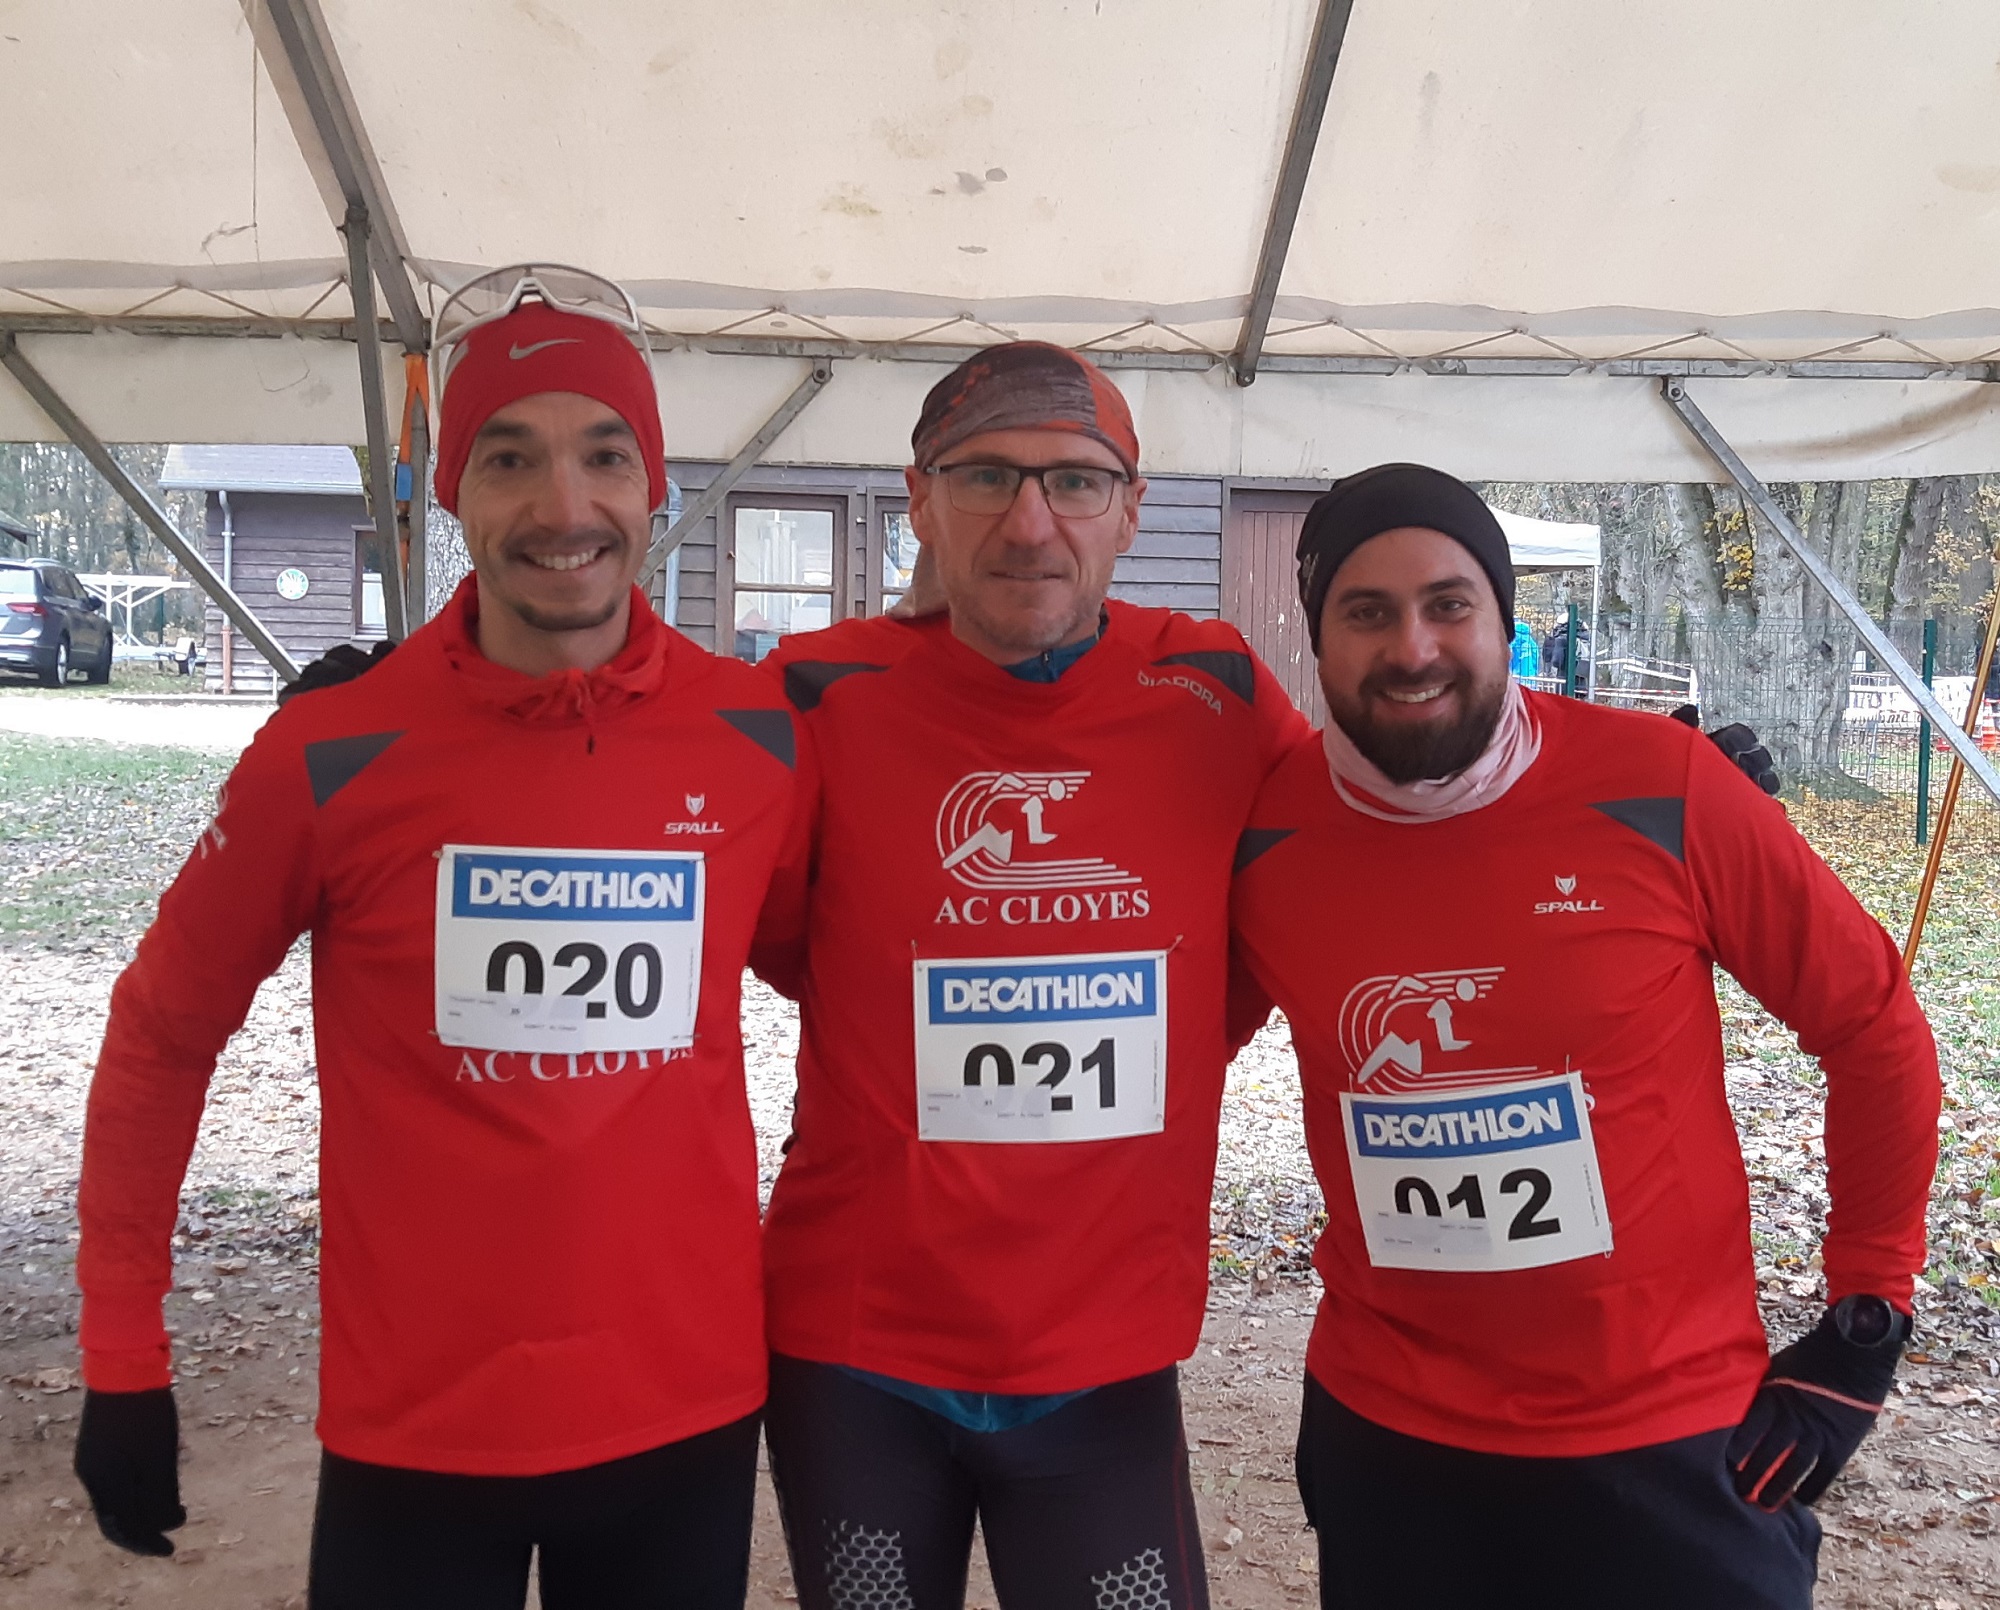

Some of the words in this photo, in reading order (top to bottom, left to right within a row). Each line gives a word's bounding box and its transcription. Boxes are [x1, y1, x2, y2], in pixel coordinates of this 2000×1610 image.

[1138, 669, 1222, 715] DIADORA
[664, 822, 725, 835] SPALL
[469, 868, 685, 909] DECATHLON
[935, 896, 989, 925] AC
[1000, 889, 1151, 924] CLOYES
[1534, 900, 1605, 914] SPALL
[486, 941, 662, 1019] 020
[943, 971, 1144, 1013] DECATHLON
[455, 1051, 516, 1083] AC
[963, 1037, 1117, 1111] 021
[1363, 1098, 1562, 1148] DECATHLON
[1394, 1168, 1562, 1241] 012
